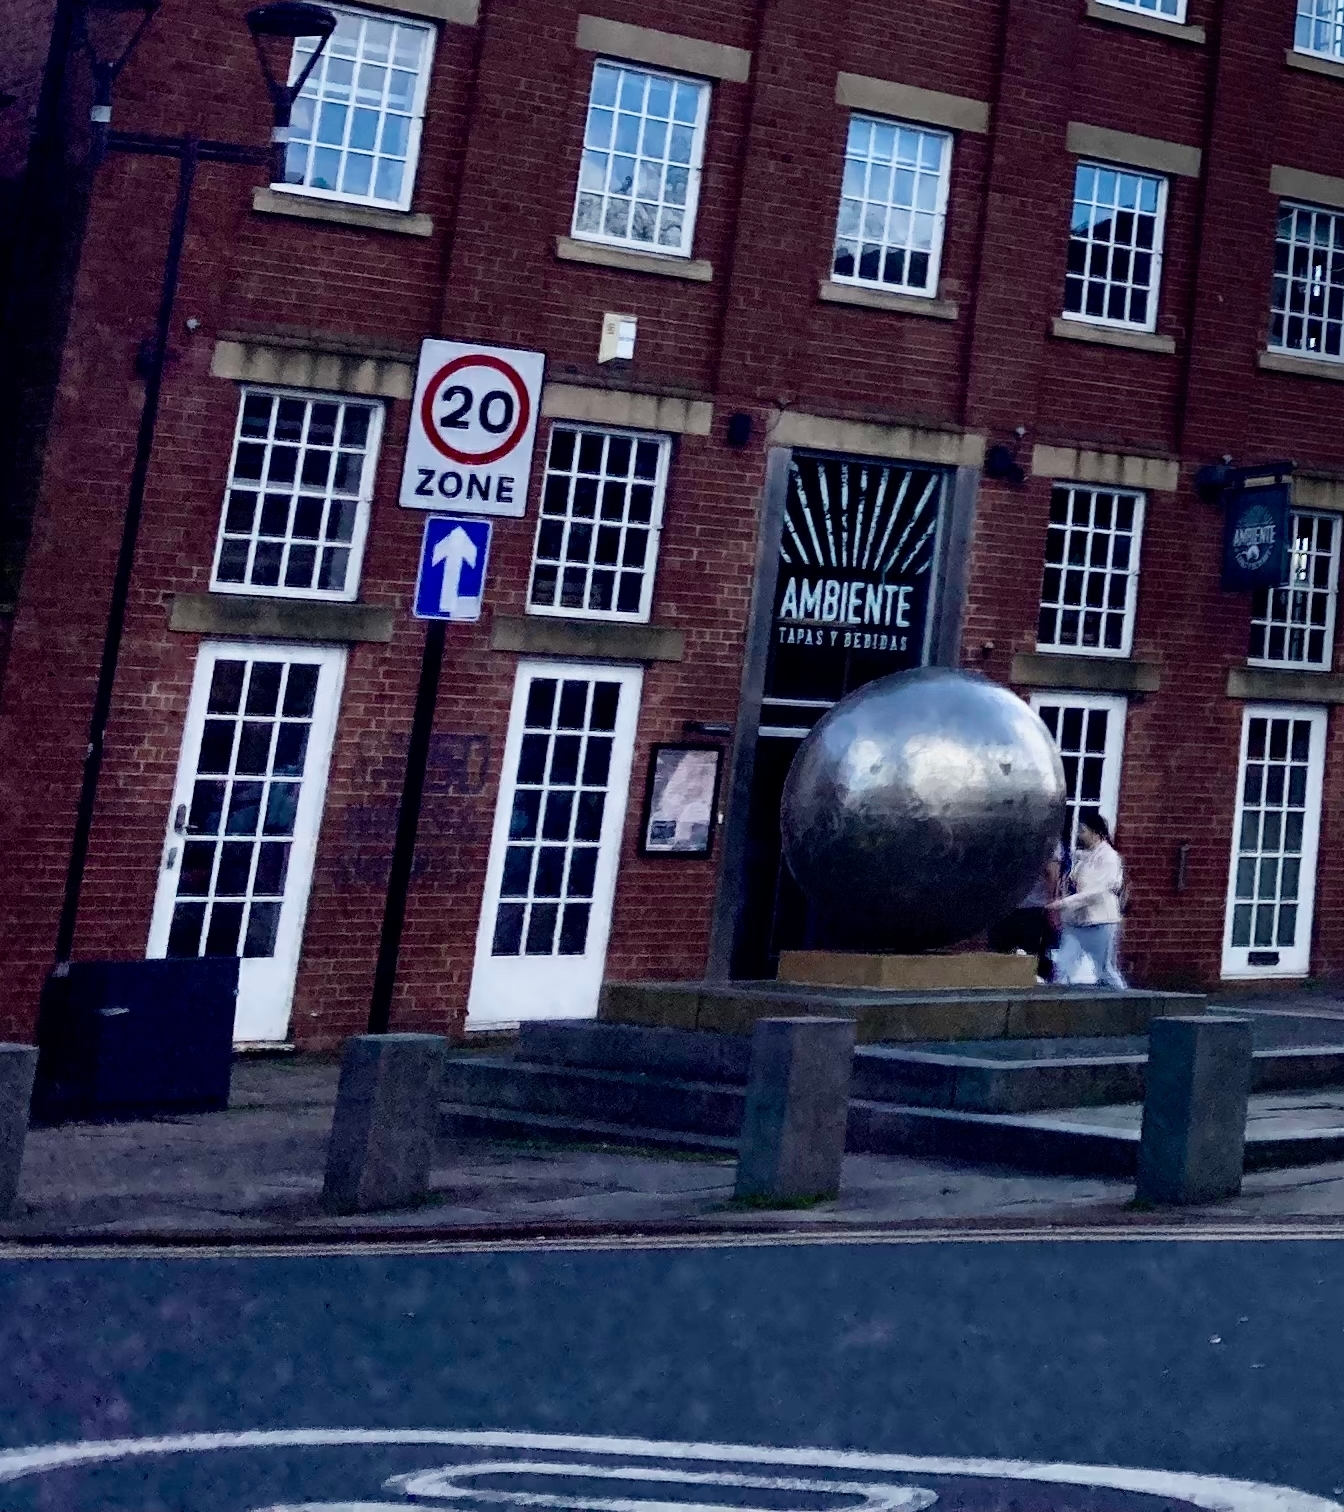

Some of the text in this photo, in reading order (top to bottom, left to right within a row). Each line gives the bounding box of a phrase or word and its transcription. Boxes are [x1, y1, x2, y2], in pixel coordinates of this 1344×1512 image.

[440, 385, 514, 434] 20
[414, 468, 515, 504] ZONE
[779, 576, 914, 628] AMBIENTE
[778, 626, 909, 652] TAPAS Y BEBIDAS
